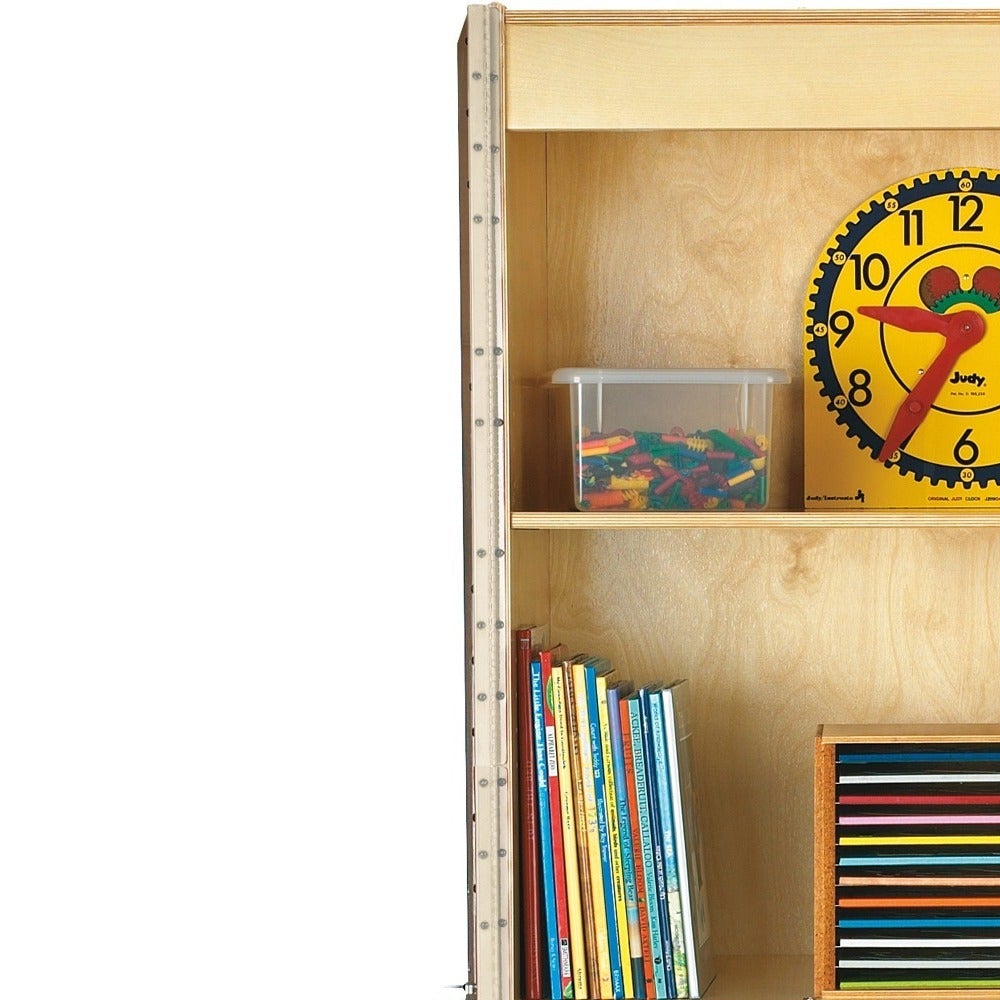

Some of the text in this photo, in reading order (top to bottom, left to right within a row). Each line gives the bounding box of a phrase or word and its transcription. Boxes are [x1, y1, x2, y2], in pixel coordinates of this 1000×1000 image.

[960, 181, 971, 189] 60
[886, 201, 897, 209] 55
[948, 195, 983, 231] 12
[899, 210, 923, 246] 11
[850, 253, 889, 291] 10
[829, 310, 855, 349] 9
[849, 369, 873, 407] 8
[950, 371, 986, 387] Judy
[953, 429, 979, 466] 6
[962, 471, 972, 479] 30
[532, 672, 541, 689] The
[533, 689, 542, 711] Little
[589, 723, 598, 738] Count
[630, 712, 641, 747] ACKEE,
[592, 752, 600, 768] Teddy
[539, 763, 548, 789] Could
[634, 749, 647, 813] BREADFRUIT,
[619, 799, 635, 902] The Legend of Sleeping Bear
[640, 816, 652, 867] CALLALOO
[646, 872, 655, 892] Valerie
